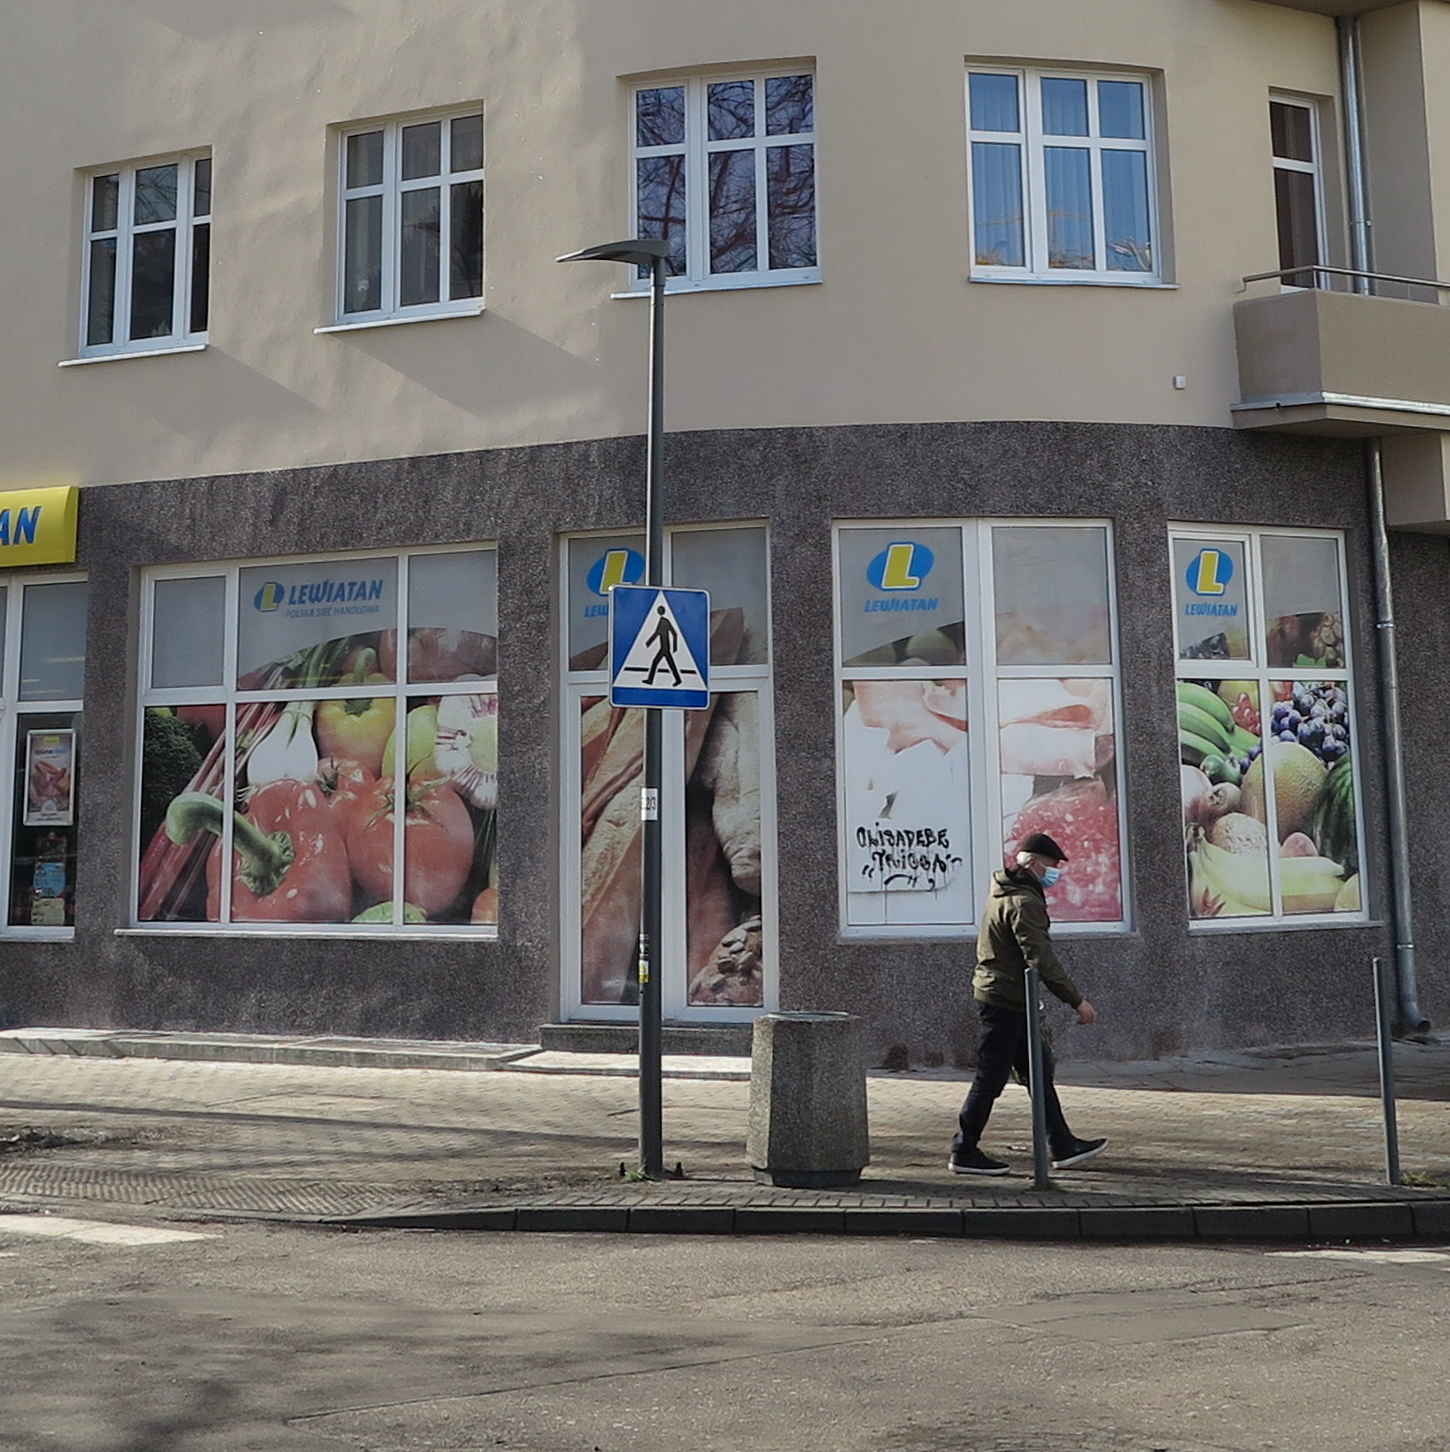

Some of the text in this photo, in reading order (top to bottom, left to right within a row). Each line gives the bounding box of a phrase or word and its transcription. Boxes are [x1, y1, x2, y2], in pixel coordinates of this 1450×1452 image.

[288, 580, 383, 605] LEWIATAN
[285, 608, 315, 618] POLSKA
[333, 604, 380, 615] HANDLOWA
[864, 597, 938, 613] LEWIATAN
[1185, 601, 1238, 616] LEWIATAN
